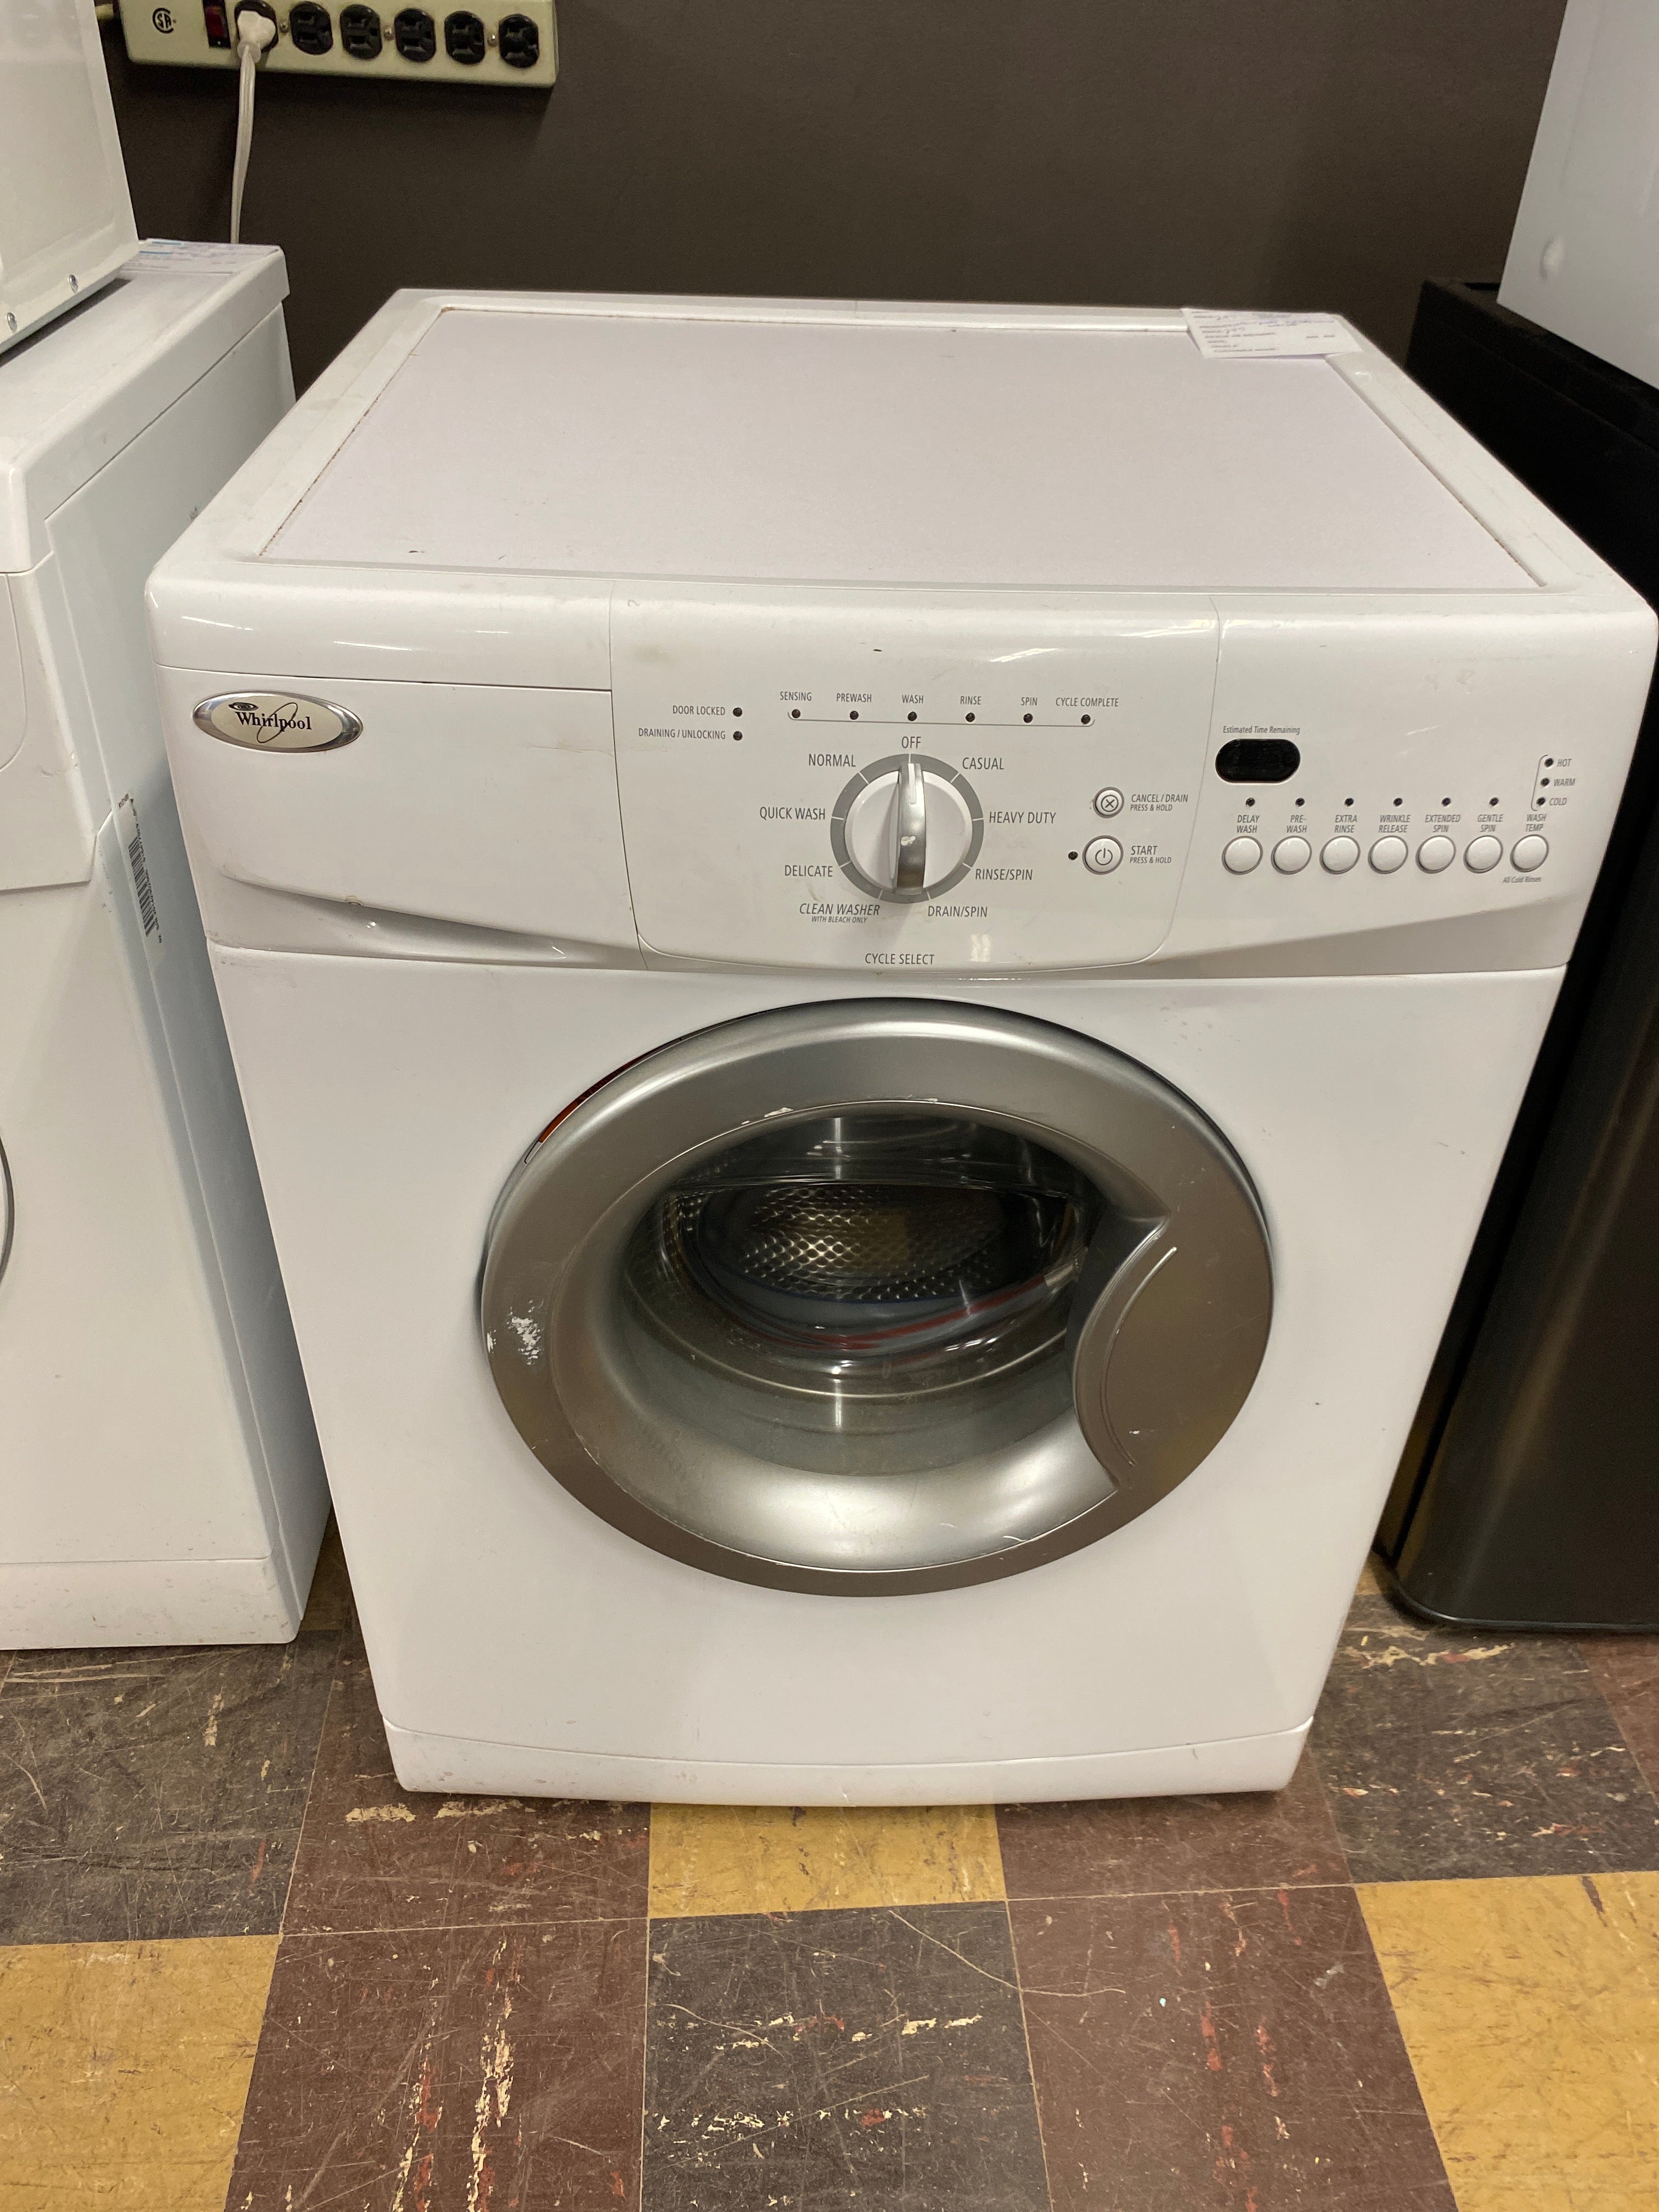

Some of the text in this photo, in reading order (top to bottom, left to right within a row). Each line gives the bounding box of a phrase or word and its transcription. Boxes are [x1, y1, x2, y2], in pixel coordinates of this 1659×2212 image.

[780, 691, 812, 702] SENSING
[836, 693, 872, 703] PREWASH
[902, 694, 924, 704] WASH
[960, 696, 981, 705] RINSE
[1021, 697, 1037, 706] SPIN
[1056, 697, 1119, 707] CYCLE COMPLETE
[673, 706, 725, 715] DOOR LOCKED
[235, 712, 312, 732] Whirlpool
[638, 728, 675, 738] DRAINING
[681, 729, 726, 740] UNLOCKING
[1269, 726, 1300, 735] Remaining
[901, 736, 922, 749] OFF
[808, 754, 856, 767] NORMAL
[962, 757, 1005, 770] CASUAL
[1557, 759, 1572, 767] HOT
[1554, 778, 1576, 787] WARM
[1131, 794, 1159, 803] CANCEL
[1165, 794, 1188, 803] DRAIN
[1549, 798, 1567, 806] COLD
[760, 806, 826, 821] QUICK WASH
[989, 812, 1056, 824] HEAVY DUTY
[1380, 814, 1410, 822] WRINKLE
[1425, 814, 1461, 822] EXTENDED
[1477, 814, 1503, 822] GENTLE
[1526, 814, 1546, 822] WASH
[1237, 815, 1260, 823] DELAY
[1290, 815, 1306, 823] PRE-
[1335, 815, 1357, 823] EXTRA
[1236, 825, 1257, 833] WASH
[1286, 825, 1307, 833] WASH
[1334, 825, 1355, 833] RINSE
[1379, 825, 1407, 833] RELEASE
[1432, 825, 1448, 833] SPIN
[1480, 824, 1496, 832] SPIN
[1131, 845, 1158, 855] START
[785, 865, 833, 877] DELICATE
[975, 869, 1032, 881] RINSE/SPIN
[799, 902, 880, 916] CLEAN WASHER
[928, 906, 988, 918] DRAIN/SPIN
[865, 953, 934, 966] CYCLE SELECT
